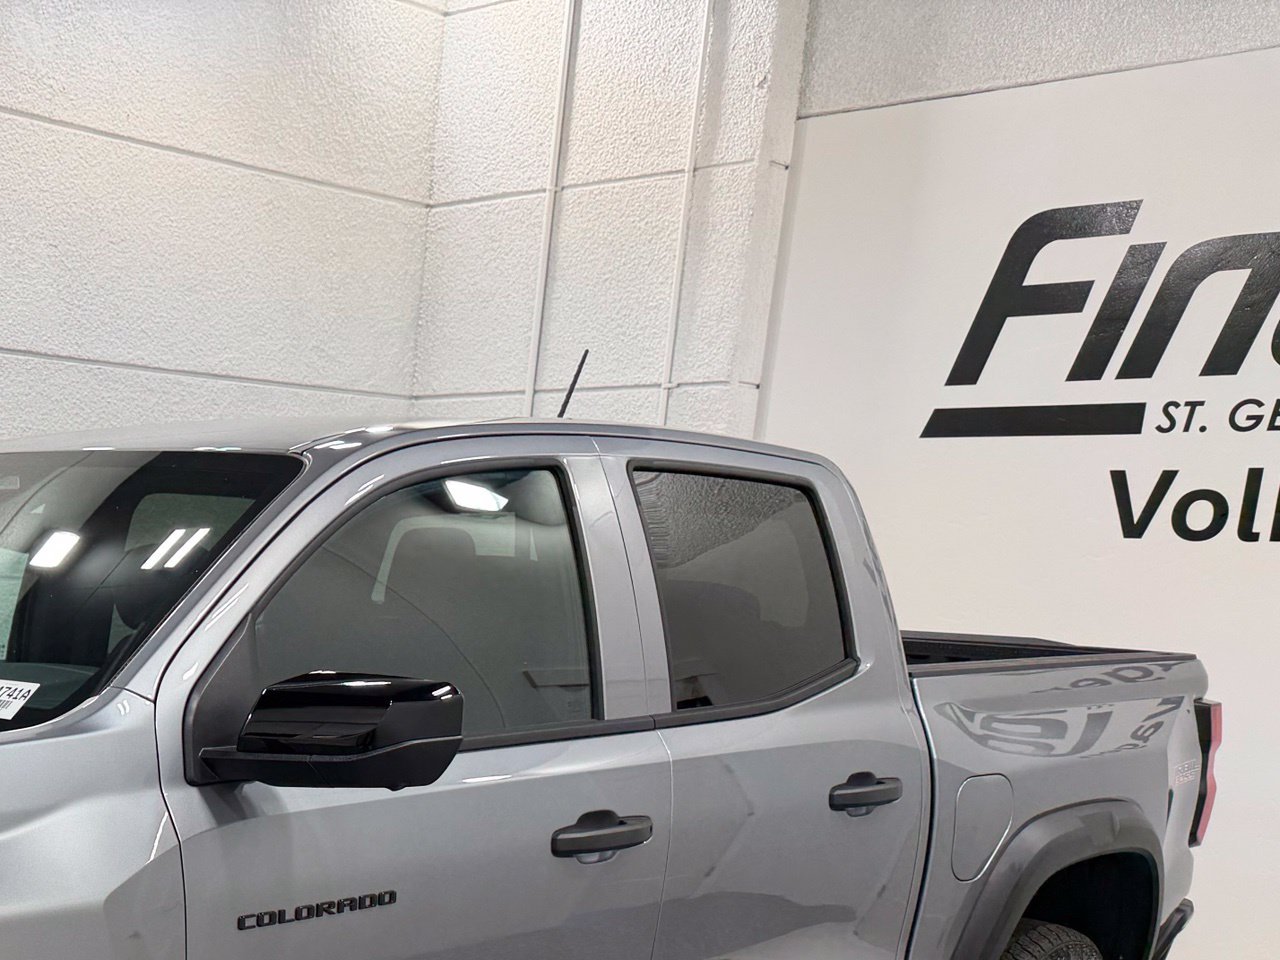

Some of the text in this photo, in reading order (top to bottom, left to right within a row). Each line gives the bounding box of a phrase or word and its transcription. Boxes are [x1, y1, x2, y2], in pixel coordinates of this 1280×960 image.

[944, 199, 1280, 386] Fin
[1155, 400, 1207, 433] ST.
[1109, 467, 1280, 542] Vol
[237, 890, 397, 931] COLORADO
